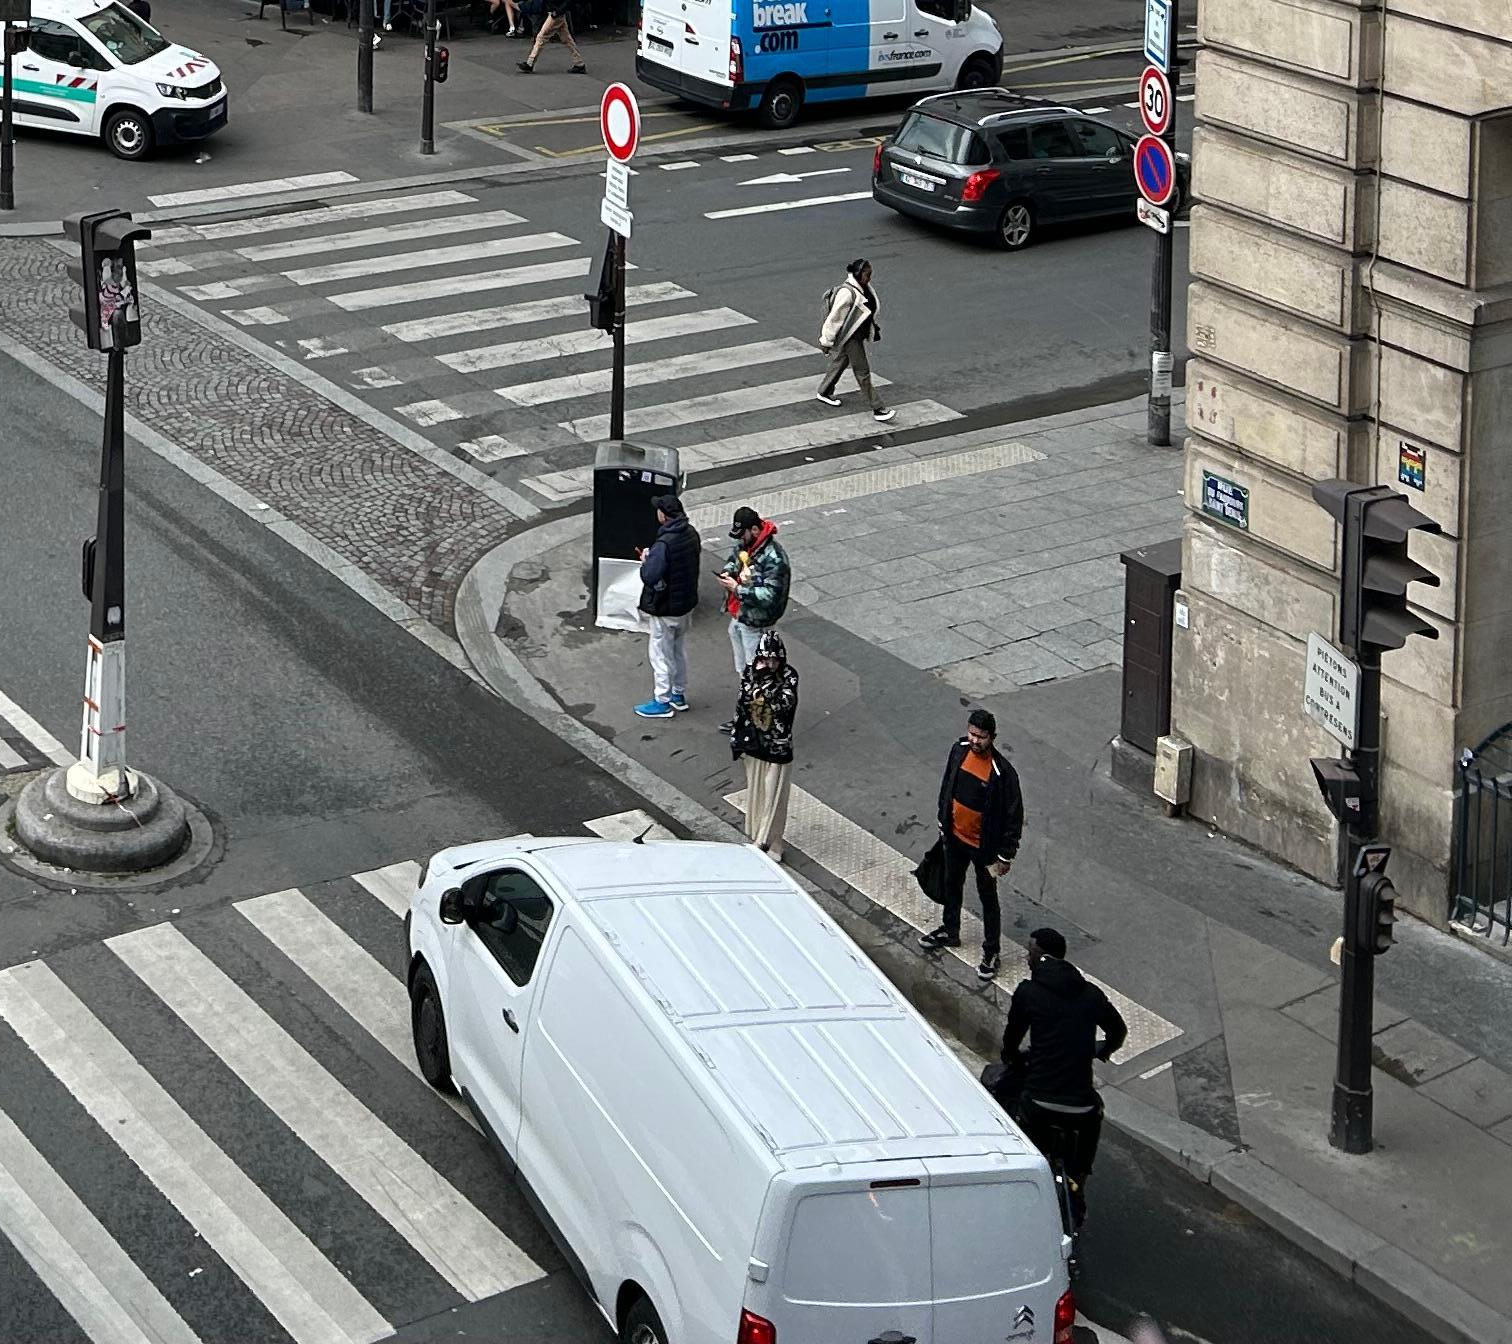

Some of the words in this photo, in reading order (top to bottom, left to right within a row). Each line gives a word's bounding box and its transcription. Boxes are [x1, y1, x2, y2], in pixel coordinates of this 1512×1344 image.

[752, 1, 809, 28] break
[754, 30, 799, 55] .com
[1146, 83, 1163, 118] 30
[1312, 663, 1351, 700] ATTENTION
[1319, 686, 1334, 706] BUS
